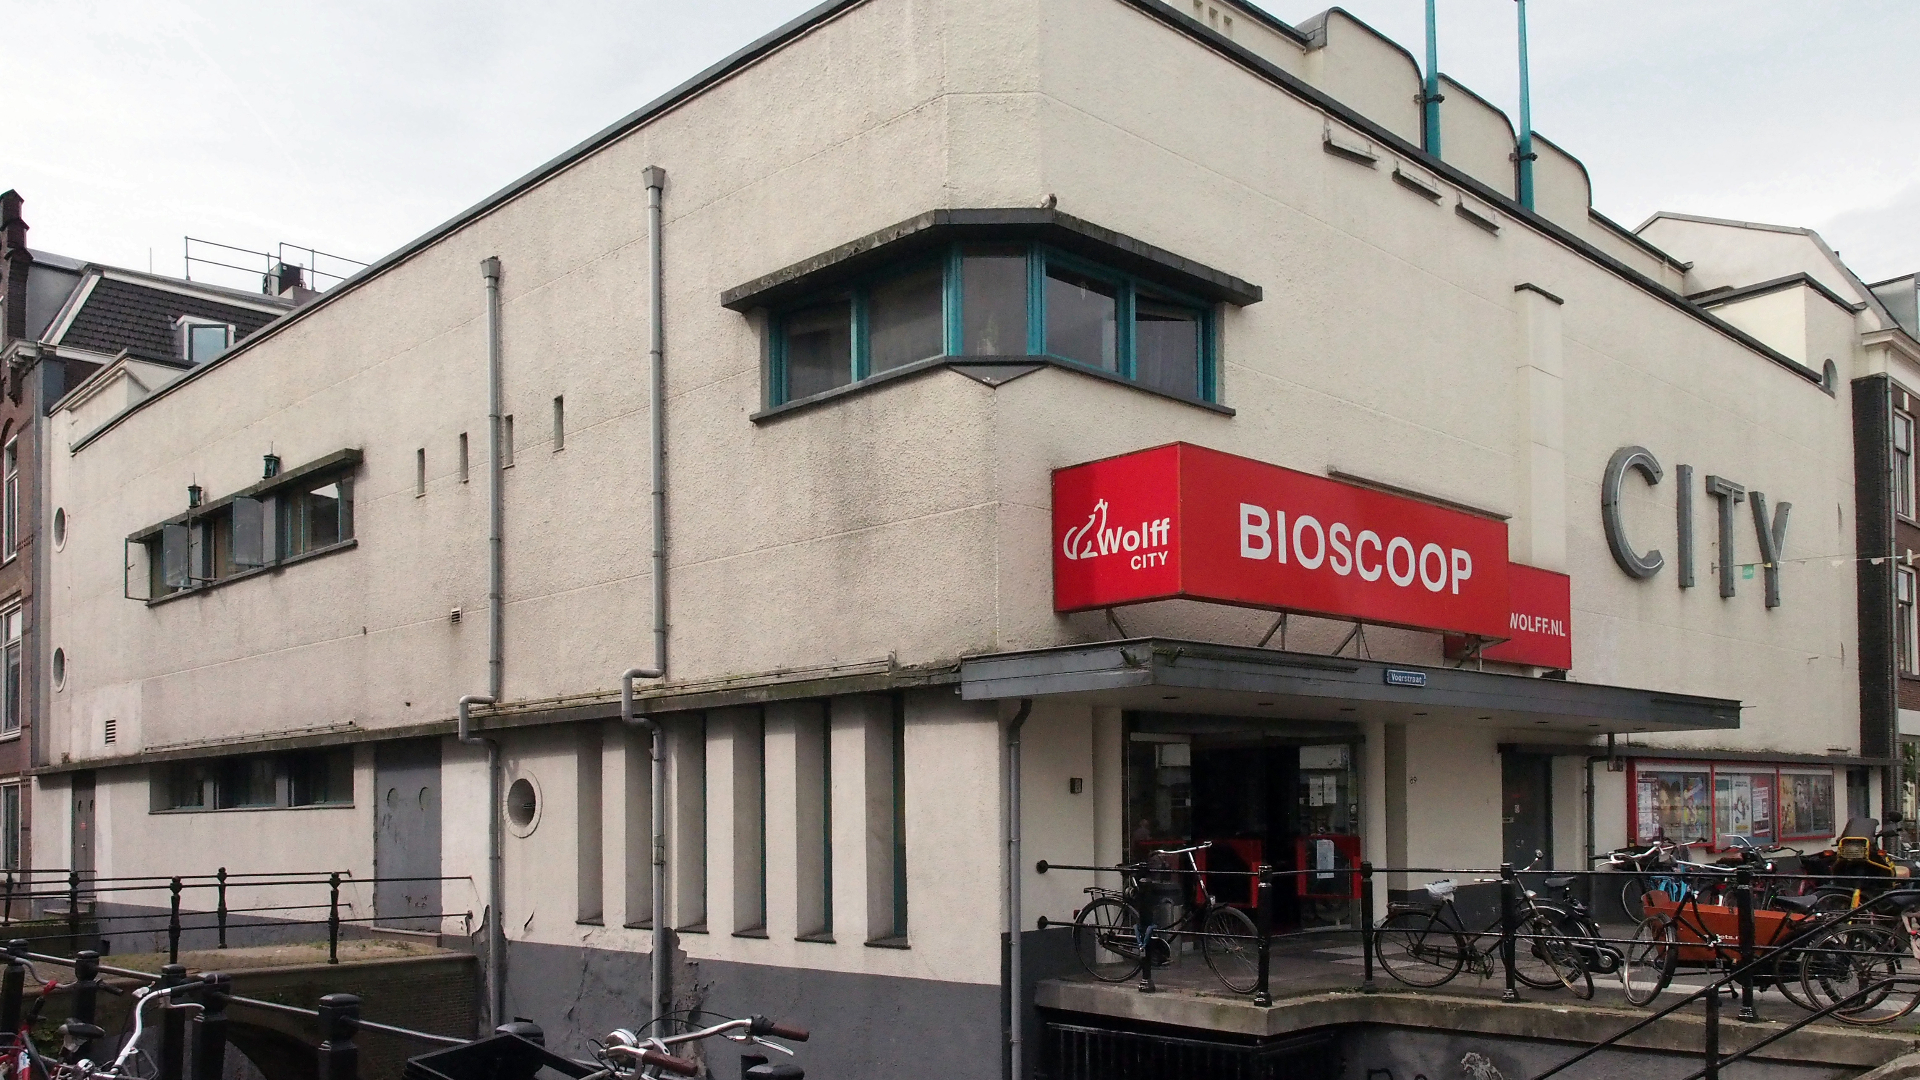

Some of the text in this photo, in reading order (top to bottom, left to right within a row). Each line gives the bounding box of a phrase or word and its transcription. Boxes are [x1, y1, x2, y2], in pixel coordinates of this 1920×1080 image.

[1097, 517, 1171, 556] Wolff
[1601, 446, 1792, 608] CITY
[1130, 550, 1169, 570] CITY
[1240, 503, 1473, 595] BIOSCOOP
[1391, 673, 1422, 684] Voorstraat
